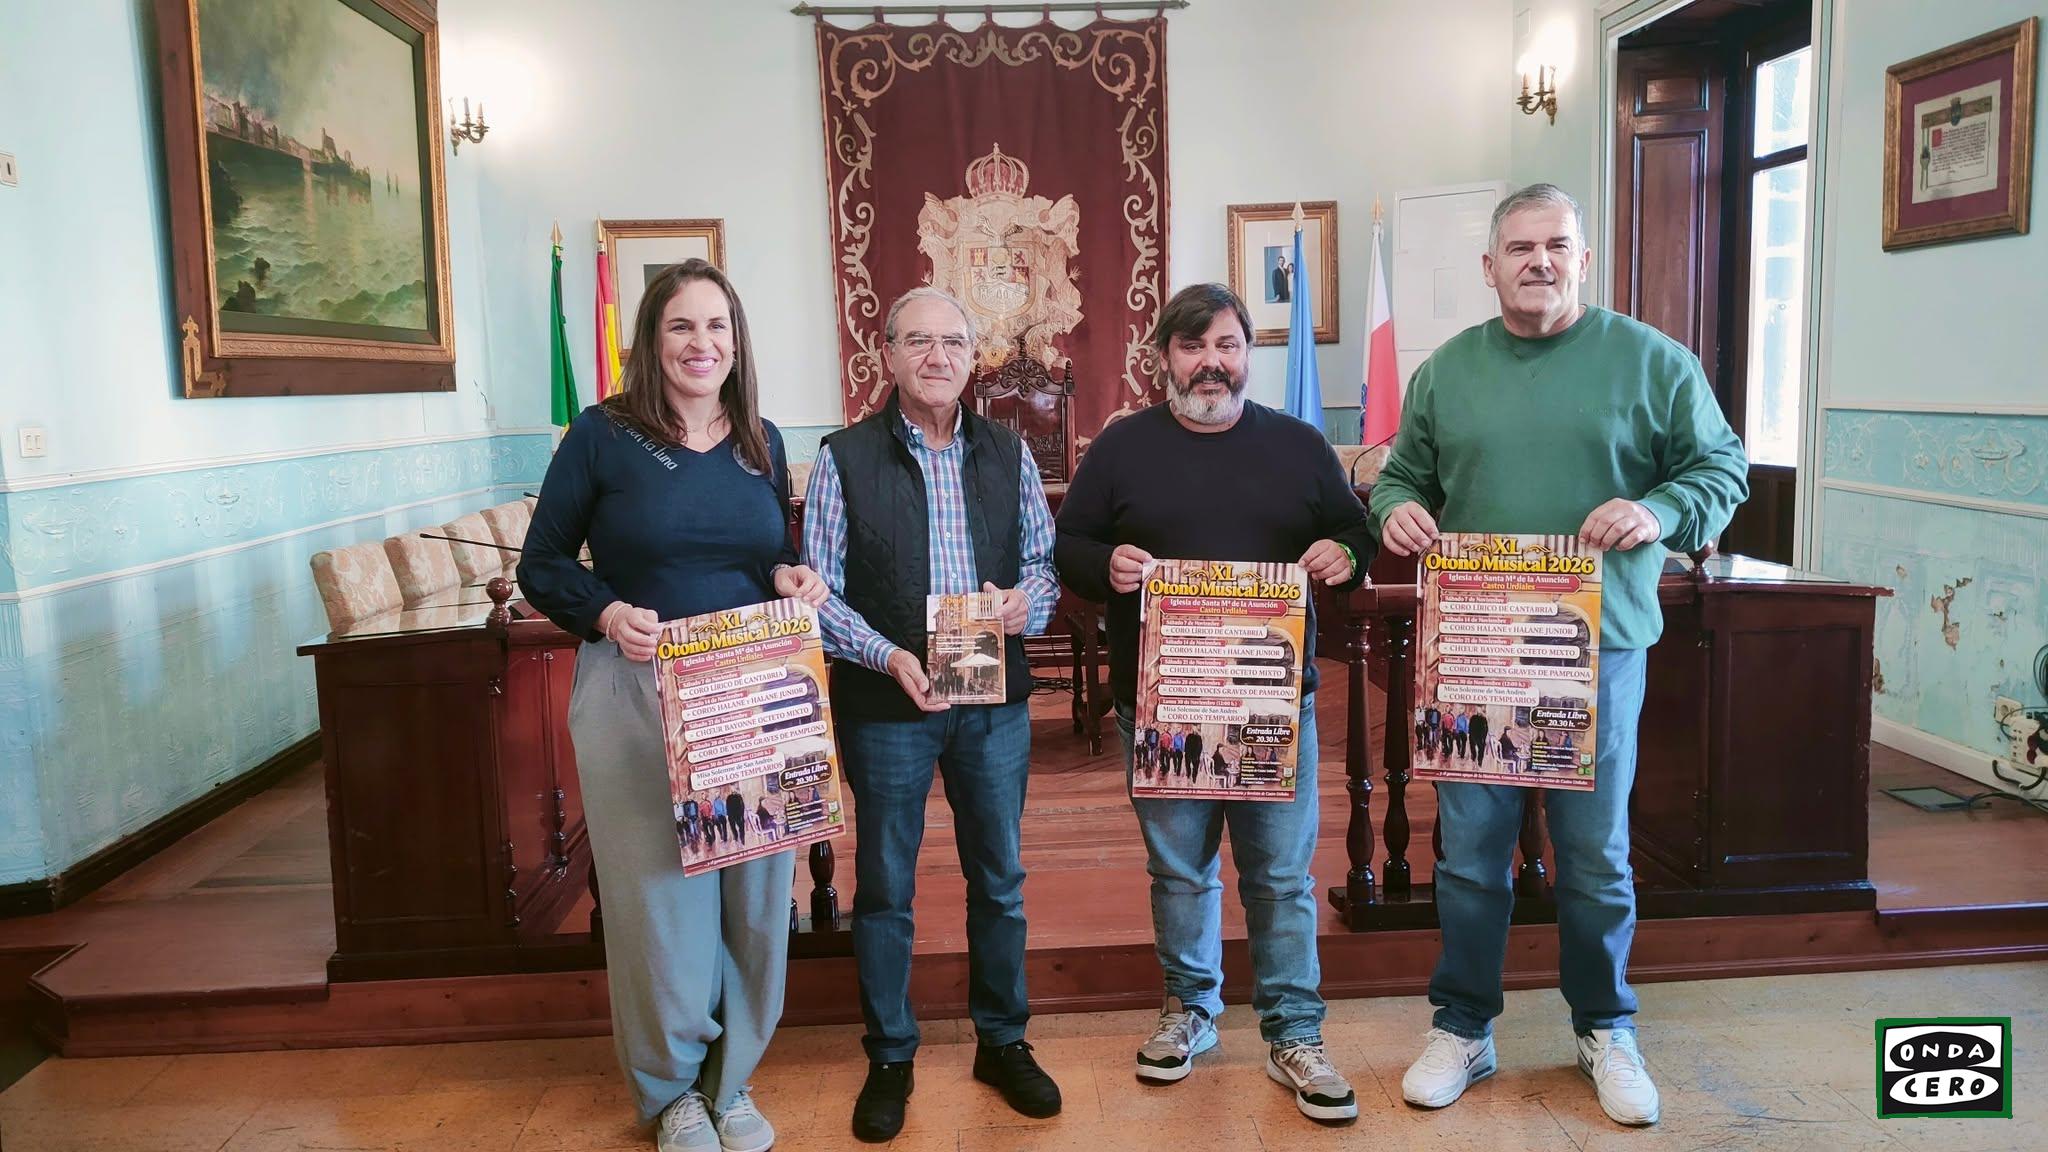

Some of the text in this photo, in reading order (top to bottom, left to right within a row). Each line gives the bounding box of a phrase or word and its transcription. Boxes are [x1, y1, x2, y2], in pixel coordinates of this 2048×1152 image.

[1493, 538, 1523, 554] XL
[1424, 552, 1595, 574] Otoño Musical 2026
[1210, 565, 1238, 580] XL
[1148, 578, 1300, 599] Otoño Musical 2026
[719, 611, 746, 631] XL
[657, 616, 812, 660] Otoño Musical 2026
[682, 656, 705, 667] Iglesia
[714, 650, 734, 659] Santa
[761, 639, 792, 650] Asunción
[714, 652, 763, 667] Castro Urdiales
[1549, 670, 1590, 678] PAMPLONA
[688, 686, 709, 695] CORO
[743, 670, 783, 684] CANTABRIA
[1489, 695, 1536, 704] TEMPLARIOS
[1536, 709, 1587, 720] Entrada Libre
[1246, 726, 1272, 734] Entrada
[698, 748, 718, 758] CORO
[730, 740, 752, 750] VOCES
[752, 734, 778, 745] GRAVES
[789, 724, 824, 736] PAMPLONA
[702, 762, 783, 786] CORO LOS TEMPLARIOS
[784, 763, 828, 779] Entrada Libre
[795, 775, 813, 785] 20.30
